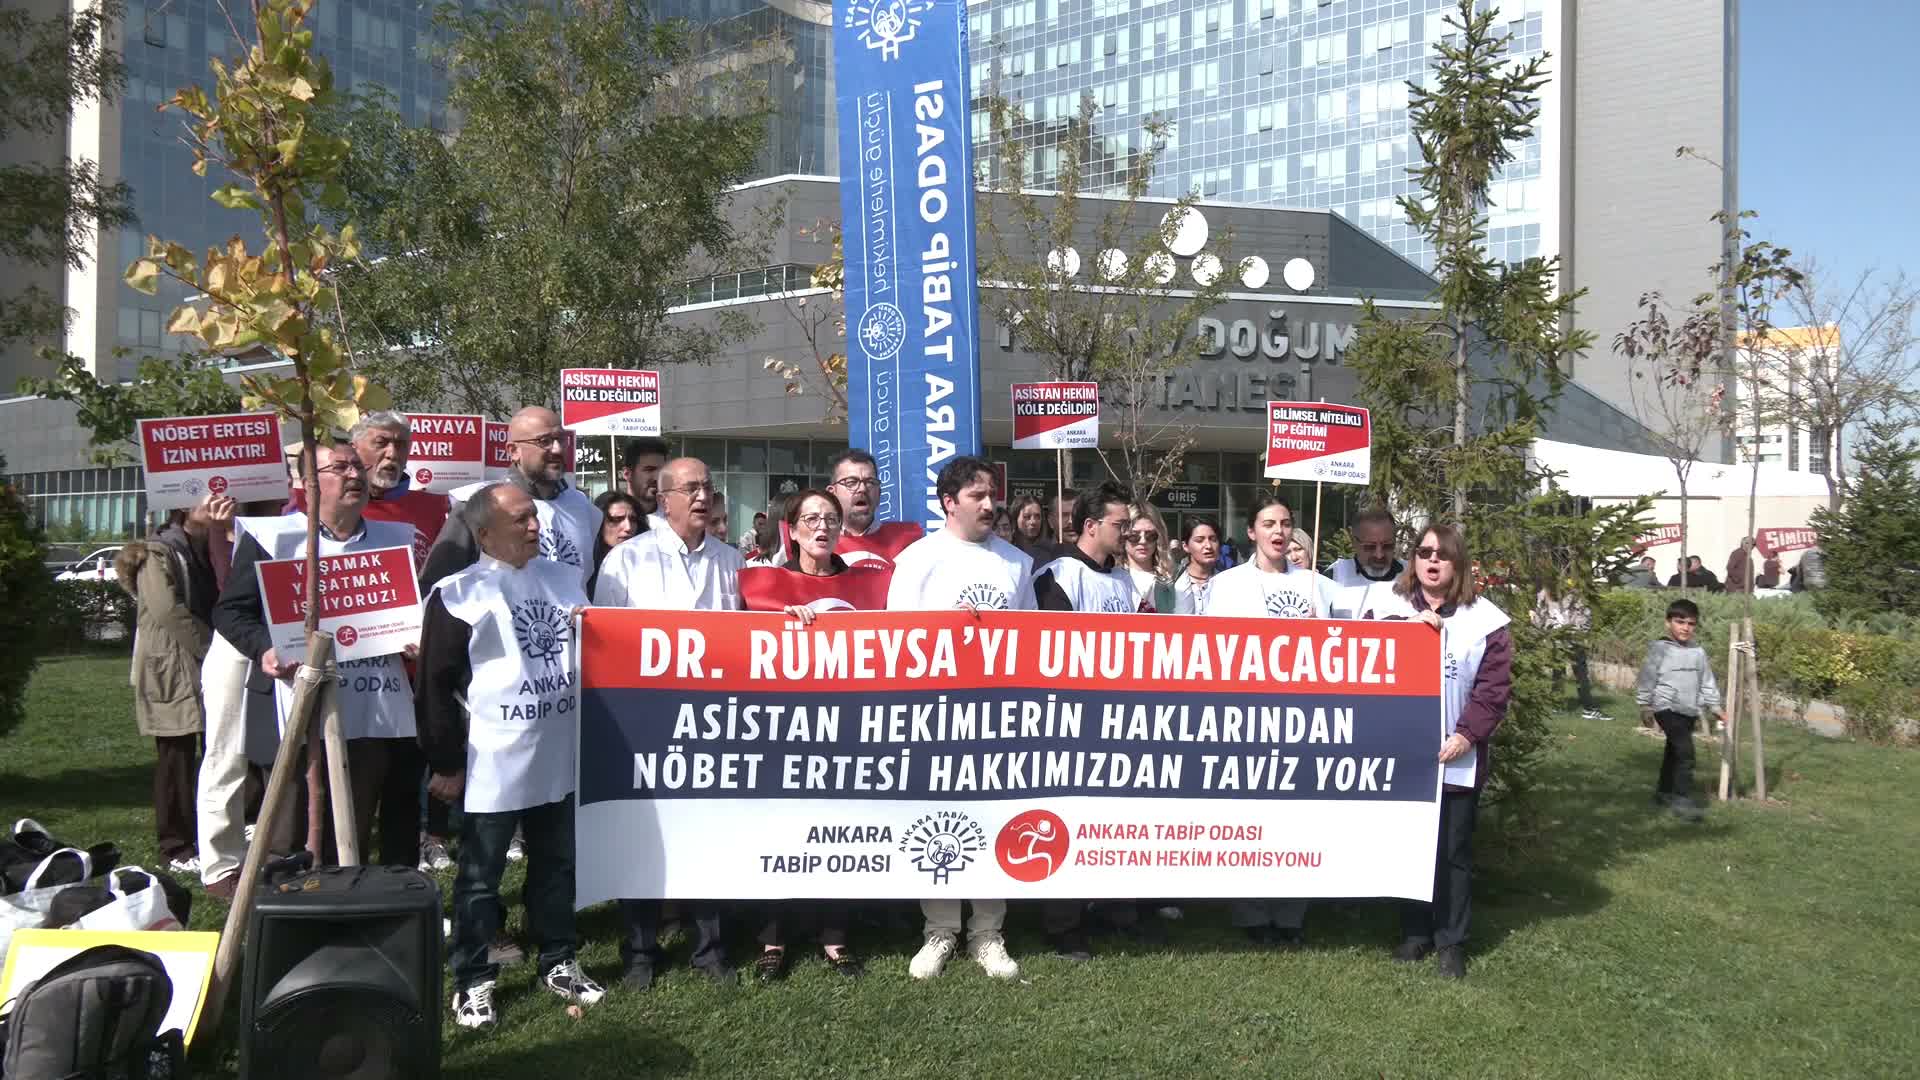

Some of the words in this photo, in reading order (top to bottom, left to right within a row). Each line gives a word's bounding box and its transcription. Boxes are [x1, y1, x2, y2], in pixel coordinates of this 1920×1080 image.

[1198, 309, 1360, 360] DOĞUM
[565, 372, 615, 387] ASİSTAN
[618, 374, 656, 388] HEKİM
[1153, 363, 1312, 409] TANESİ
[567, 387, 597, 401] KÖLE
[600, 389, 657, 403] DEĞİLDİR!
[1015, 386, 1060, 400] ASİSTAN
[1063, 386, 1095, 399] HEKİM
[1017, 402, 1045, 415] KÖLE
[1047, 401, 1096, 415] DEĞİLDİR!
[1273, 408, 1319, 421] BİLİMSEL
[1320, 411, 1362, 426] NİTELİKLİ
[152, 425, 209, 442] NÖBET
[213, 420, 271, 438] ERTESİ
[410, 419, 476, 435] ARYAYA
[1273, 424, 1289, 434] TIP
[1290, 423, 1327, 437] EĞİTİMİ
[162, 447, 197, 464] İZİN
[201, 443, 266, 461] HAKTIR!
[410, 441, 453, 456] AYIR!
[1272, 435, 1326, 451] İSTİYORUZ!
[1168, 490, 1197, 504] GİRİŞ
[294, 554, 382, 575] YŞAMAK
[292, 571, 391, 595] YŞATMAK
[293, 589, 397, 614] İSİYORUZ!
[640, 628, 724, 679] DR.
[749, 621, 1018, 680] RÜMEYSA’YI
[1038, 627, 1396, 684] UNUTMAYACAĞIZ!
[500, 699, 552, 720] TABİP
[672, 697, 840, 742] ASİSTAN
[859, 695, 1083, 743] HEKİMLERİN
[1101, 703, 1354, 744] HAKLARINDAN
[632, 746, 764, 789] NÖBET
[782, 749, 910, 791] ERTESİ
[928, 751, 1183, 791] HAKKIMIZDAN
[1201, 749, 1300, 791] TAVİZ
[1316, 757, 1396, 792] YOK!
[806, 826, 892, 844] ANKARA
[899, 815, 933, 853] ANKARA
[937, 811, 969, 821] TABİP
[970, 821, 987, 851] ODASI
[1076, 824, 1152, 839] ANKARA
[1154, 820, 1206, 841] TABİP
[1209, 825, 1263, 841] ODASI
[760, 852, 822, 873] TABİP
[826, 854, 891, 873] ODASI
[1075, 846, 1152, 867] ASİSTAN
[1156, 847, 1213, 867] HEKİM
[1216, 848, 1322, 869] KOMİSYONU
